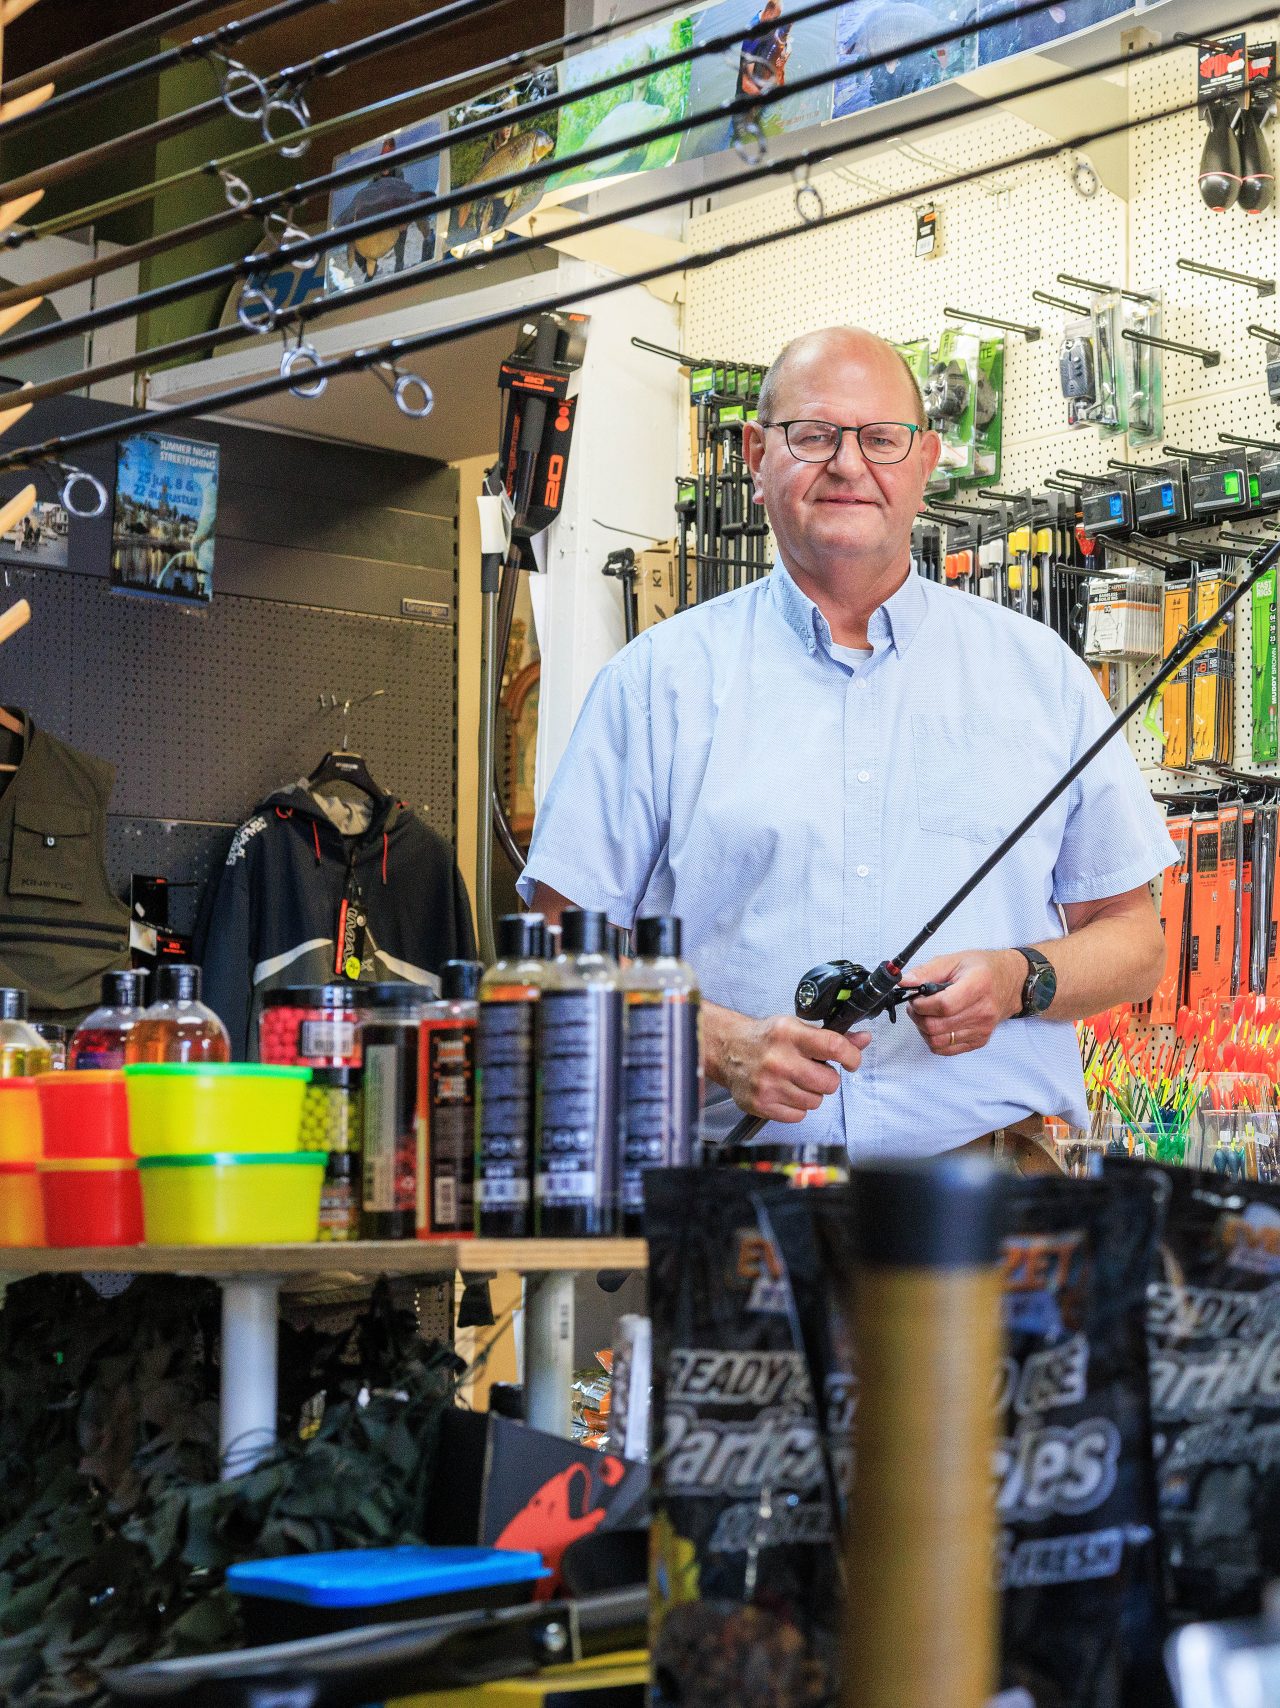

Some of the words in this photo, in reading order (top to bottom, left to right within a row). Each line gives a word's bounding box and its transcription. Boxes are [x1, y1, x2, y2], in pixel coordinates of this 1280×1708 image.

[160, 440, 192, 455] SUMMER
[193, 446, 217, 460] NIGHT
[160, 451, 216, 471] STREETFISHING
[544, 454, 564, 509] 20
